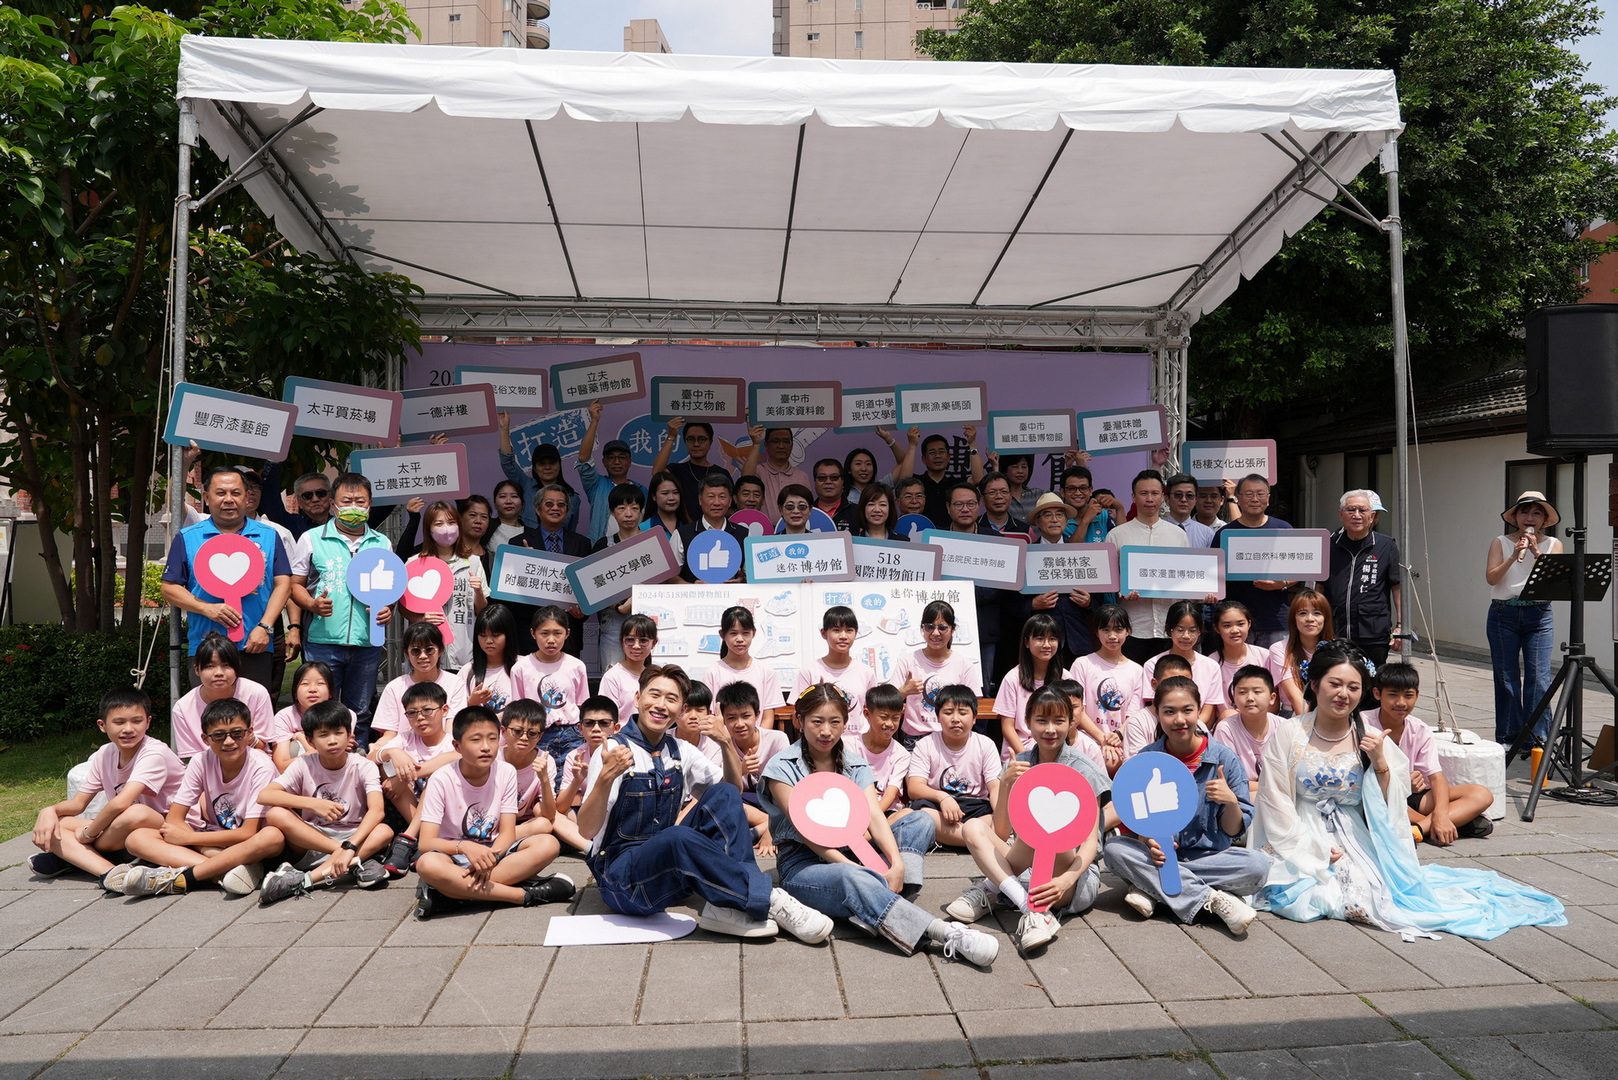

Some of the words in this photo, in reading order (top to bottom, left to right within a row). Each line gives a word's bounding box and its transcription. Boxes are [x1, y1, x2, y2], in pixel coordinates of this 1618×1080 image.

[586, 370, 608, 381] 立夫
[566, 378, 632, 397] 中醫藥博物館
[681, 389, 714, 400] 臺中市
[780, 393, 810, 404] 臺中市
[670, 400, 726, 412] 眷村文物館
[855, 397, 894, 409] 明道中學
[910, 400, 972, 412] 寶熊漁樂碼頭
[307, 402, 377, 424] 太平買菸場
[417, 404, 469, 419] 一德洋樓
[765, 405, 825, 416] 美術家資料館
[193, 410, 271, 437] 豐原漆藝館
[1018, 422, 1046, 432] 臺中市
[1102, 418, 1142, 430] 臺灣味噌
[517, 418, 584, 462] 打造
[629, 430, 680, 454] 我的
[397, 461, 422, 474] 太平
[1192, 456, 1267, 470] 梧棲文化出張所
[373, 474, 448, 491] 古農莊文物館
[877, 552, 901, 566] 518
[1043, 557, 1092, 568] 霧峰林家
[1235, 552, 1314, 562] 國立自然科學博物館
[592, 552, 654, 589] 臺中文學館
[776, 562, 798, 573] 迷你
[801, 558, 843, 572] 博物館
[1038, 569, 1099, 580] 宮保第園區
[1139, 568, 1206, 580] 國家漫畫博物館
[453, 576, 466, 625] 謝家宜
[890, 587, 914, 599] 迷你
[915, 589, 961, 604] 博物館
